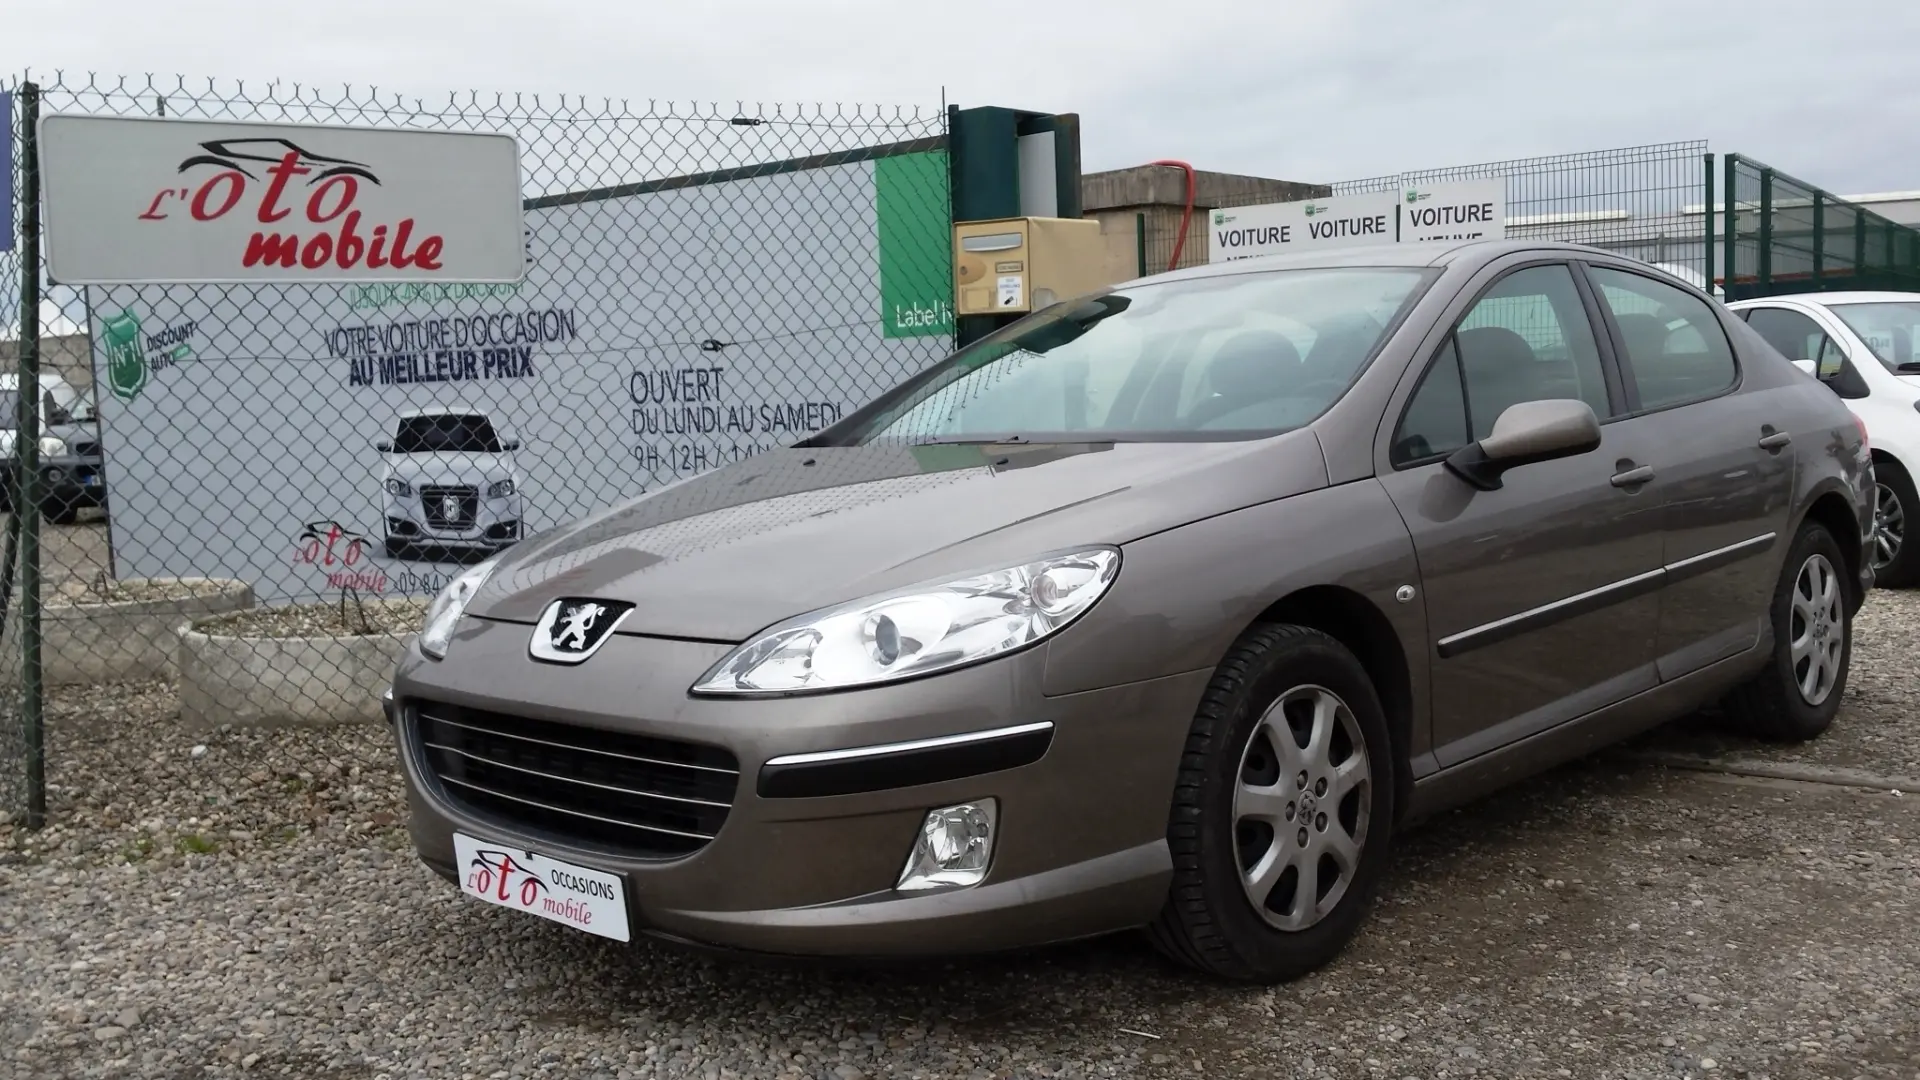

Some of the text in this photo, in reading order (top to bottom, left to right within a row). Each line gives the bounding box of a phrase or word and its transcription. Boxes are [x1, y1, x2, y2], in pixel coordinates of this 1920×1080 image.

[1308, 215, 1386, 240] VOITURE
[1410, 202, 1493, 228] VOITURE
[243, 210, 444, 270] mobile
[1218, 225, 1291, 248] VOITURE
[896, 299, 939, 328] Label
[146, 321, 195, 351] DISCOUNT
[323, 308, 577, 357] VOTRE VOITURE D'OCCASION
[150, 352, 176, 372] AUTO
[350, 345, 535, 387] AU MEILLEUR PRIX
[630, 367, 724, 404] OUVERT
[632, 401, 842, 435] DU LUNDI AU SAMEDI
[325, 568, 388, 593] mobile
[551, 869, 615, 901] OCCASIONS
[543, 897, 592, 925] mobile
